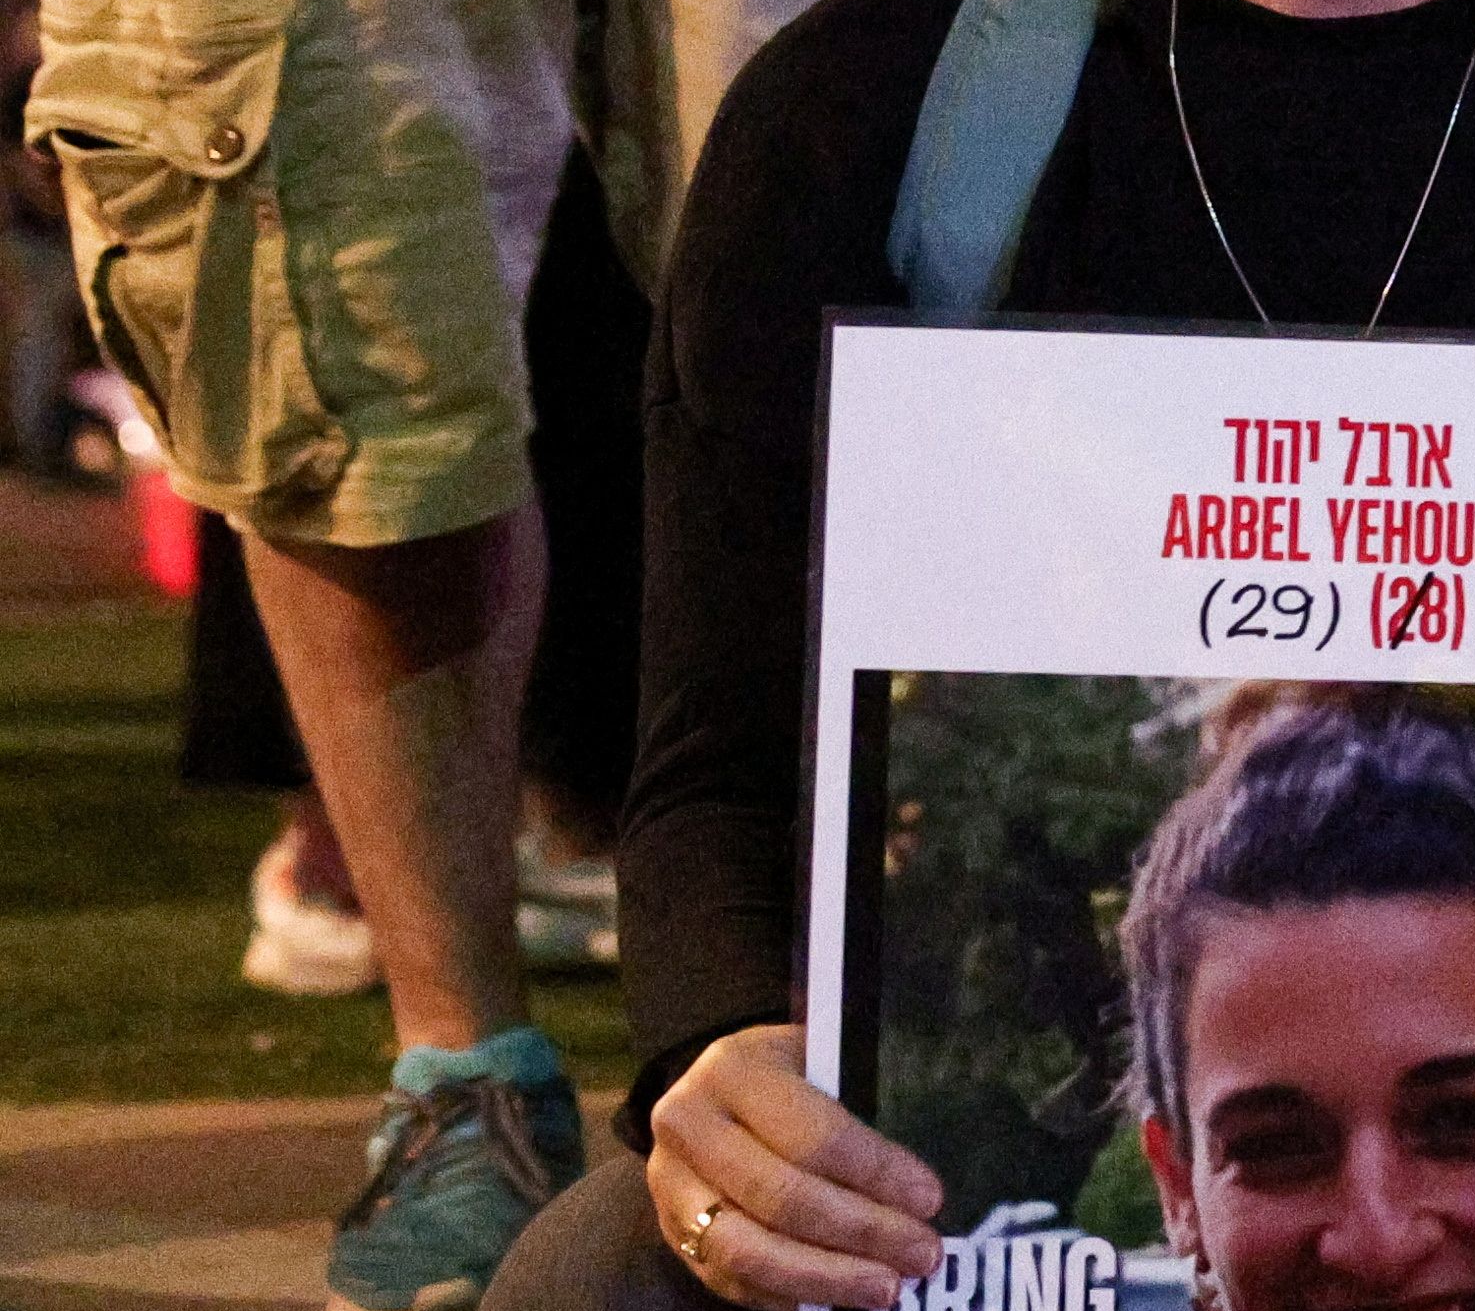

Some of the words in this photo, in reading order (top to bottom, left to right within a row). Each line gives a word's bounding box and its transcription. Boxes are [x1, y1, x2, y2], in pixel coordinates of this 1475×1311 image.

[1225, 418, 1320, 484] יהוד
[1339, 416, 1452, 488] ארבל
[1161, 493, 1311, 561] ARBEL
[1199, 578, 1341, 652] (29)
